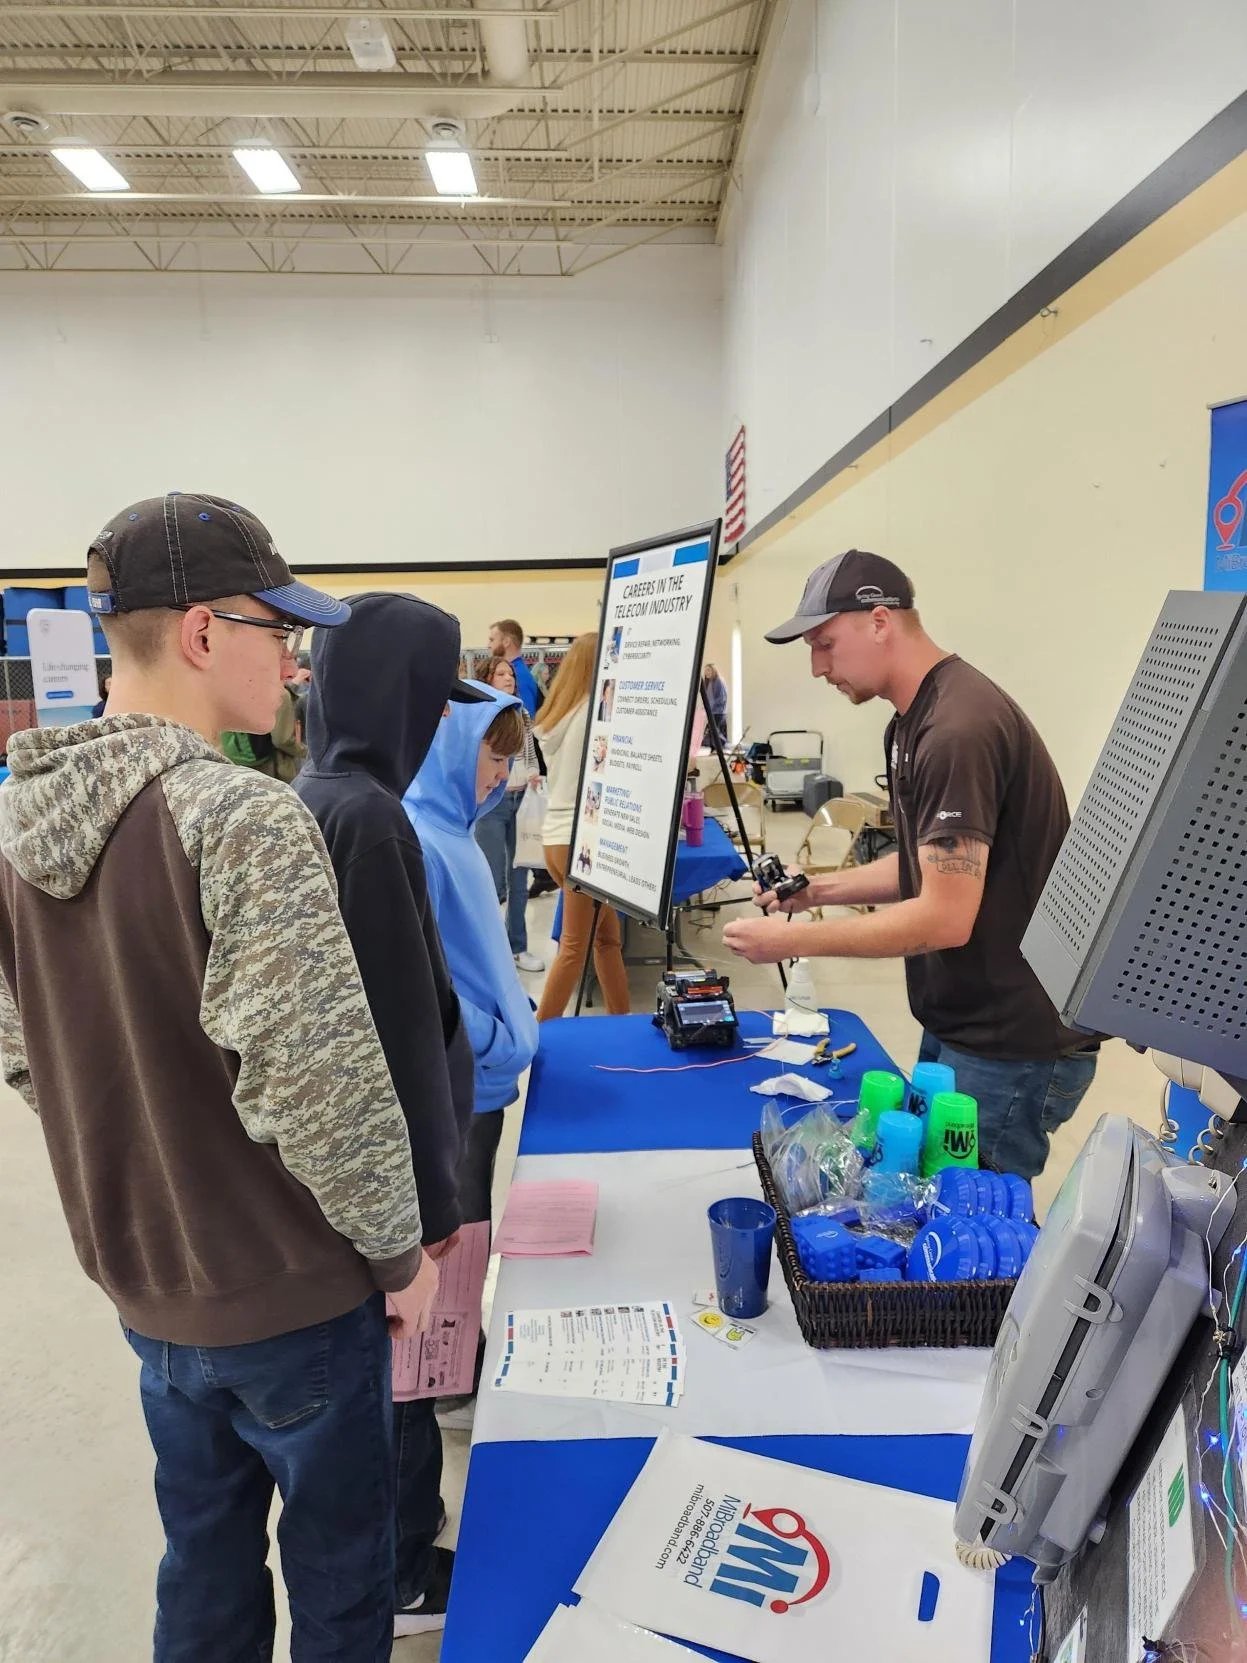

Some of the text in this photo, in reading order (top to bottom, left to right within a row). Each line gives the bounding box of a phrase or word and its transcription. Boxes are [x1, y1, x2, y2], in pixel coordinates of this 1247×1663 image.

[614, 594, 693, 619] TELECOM INDUSTRY
[622, 574, 685, 599] CAREERS IN THE
[619, 680, 666, 691] CUSTOMER SERVICE
[656, 1484, 705, 1570] mibroadband.com
[676, 1498, 715, 1565] 507-886-6422
[683, 1494, 741, 1588] MiBroadband
